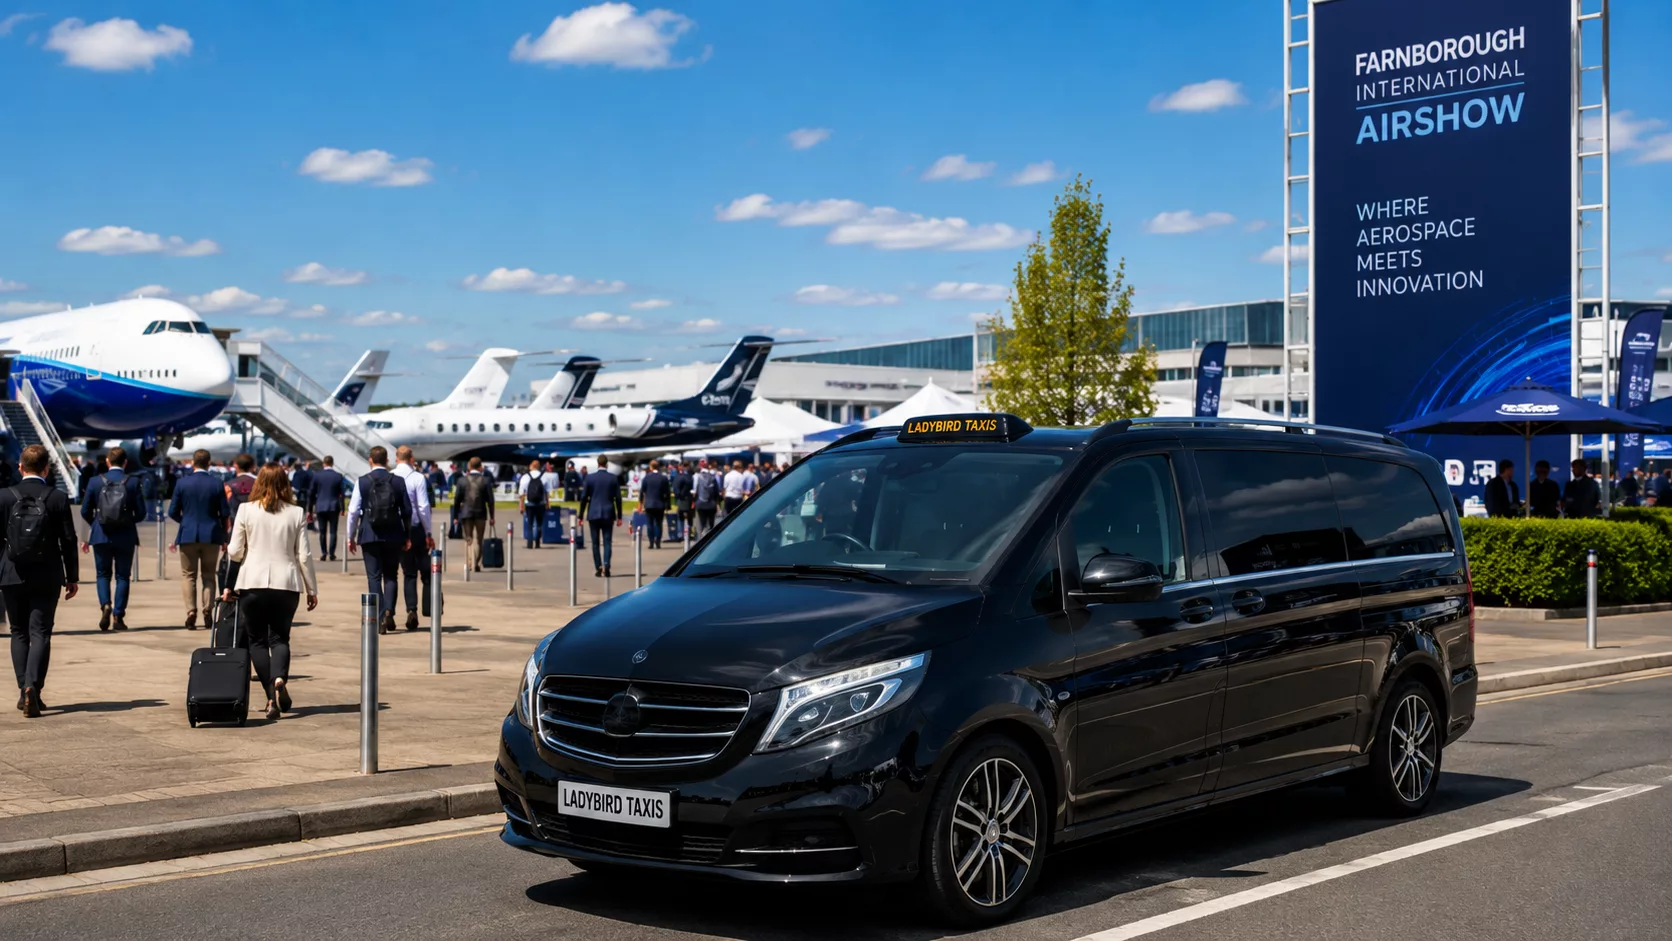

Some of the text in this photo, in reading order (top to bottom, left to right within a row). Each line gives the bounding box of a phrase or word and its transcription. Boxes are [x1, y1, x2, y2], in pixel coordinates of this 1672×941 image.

[1355, 26, 1525, 76] FARNBOROUGH
[1356, 59, 1525, 101] INTERNATIONAL
[1355, 92, 1525, 145] AIRSHOW
[1356, 196, 1429, 221] WHERE
[1356, 217, 1476, 247] AEROSPACE
[1357, 249, 1422, 272] MEETS
[1357, 270, 1484, 298] INNOVATION
[907, 419, 997, 433] LADYBIRD TAXIS
[563, 788, 663, 819] LADYBIRD TAXIS
